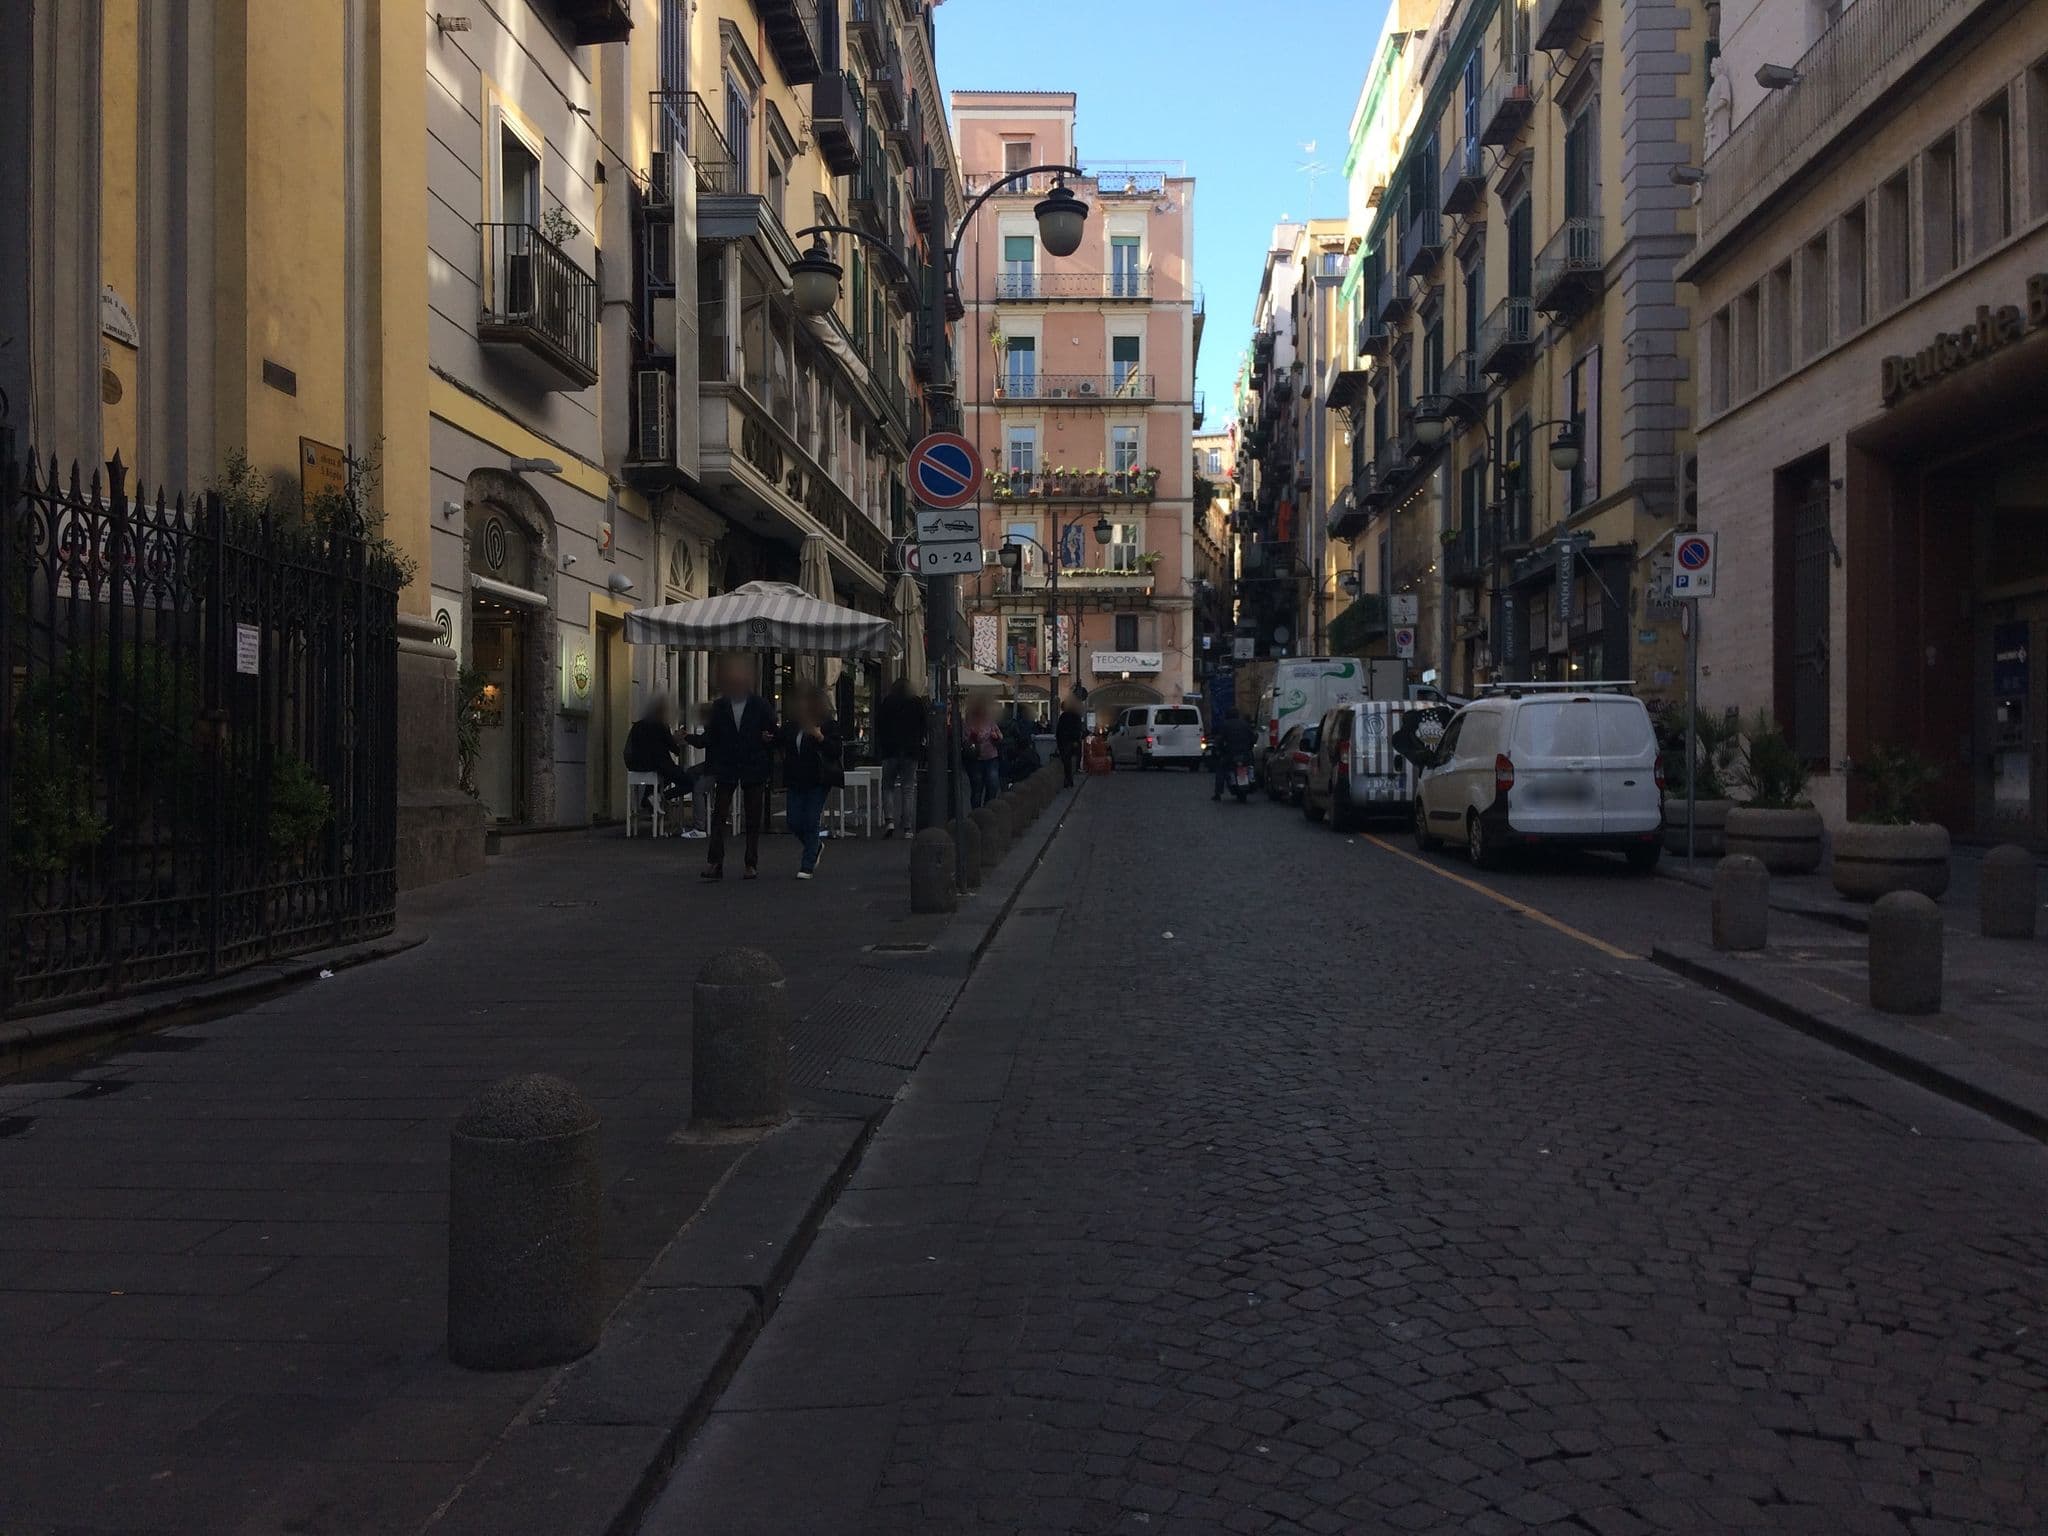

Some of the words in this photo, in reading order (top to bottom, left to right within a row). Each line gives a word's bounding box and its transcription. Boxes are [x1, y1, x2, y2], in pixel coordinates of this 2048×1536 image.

[1882, 304, 2021, 401] Deutsche
[928, 553, 938, 565] 0
[953, 551, 973, 564] 24
[1095, 655, 1138, 665] TEDORA
